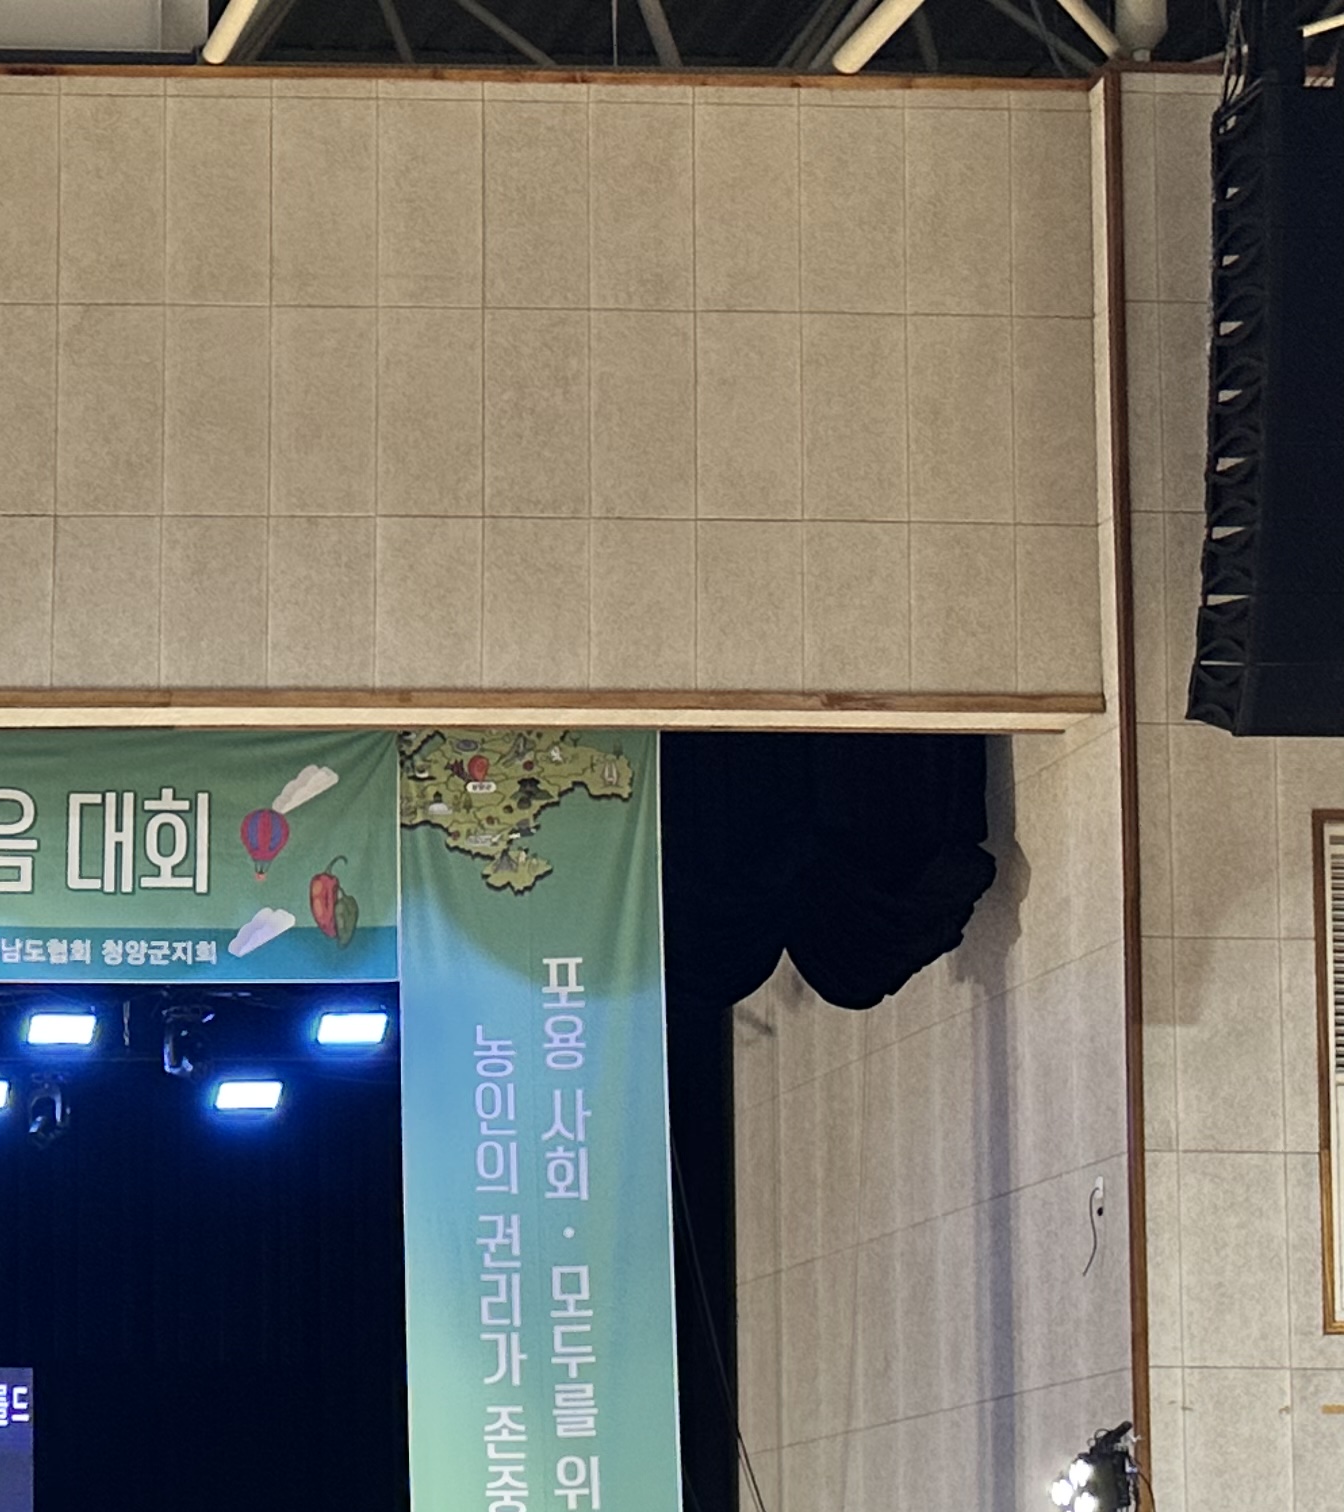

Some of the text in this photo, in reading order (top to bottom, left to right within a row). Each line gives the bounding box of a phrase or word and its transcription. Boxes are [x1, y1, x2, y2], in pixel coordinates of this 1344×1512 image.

[66, 786, 211, 895] 대회
[102, 939, 218, 966] 청양군지회
[541, 956, 587, 1070] 포용
[473, 1024, 520, 1195] 농인의
[541, 1089, 593, 1201] 사회
[475, 1213, 529, 1387] 권리가
[549, 1264, 600, 1438] 모두를
[11, 1386, 30, 1423] 드
